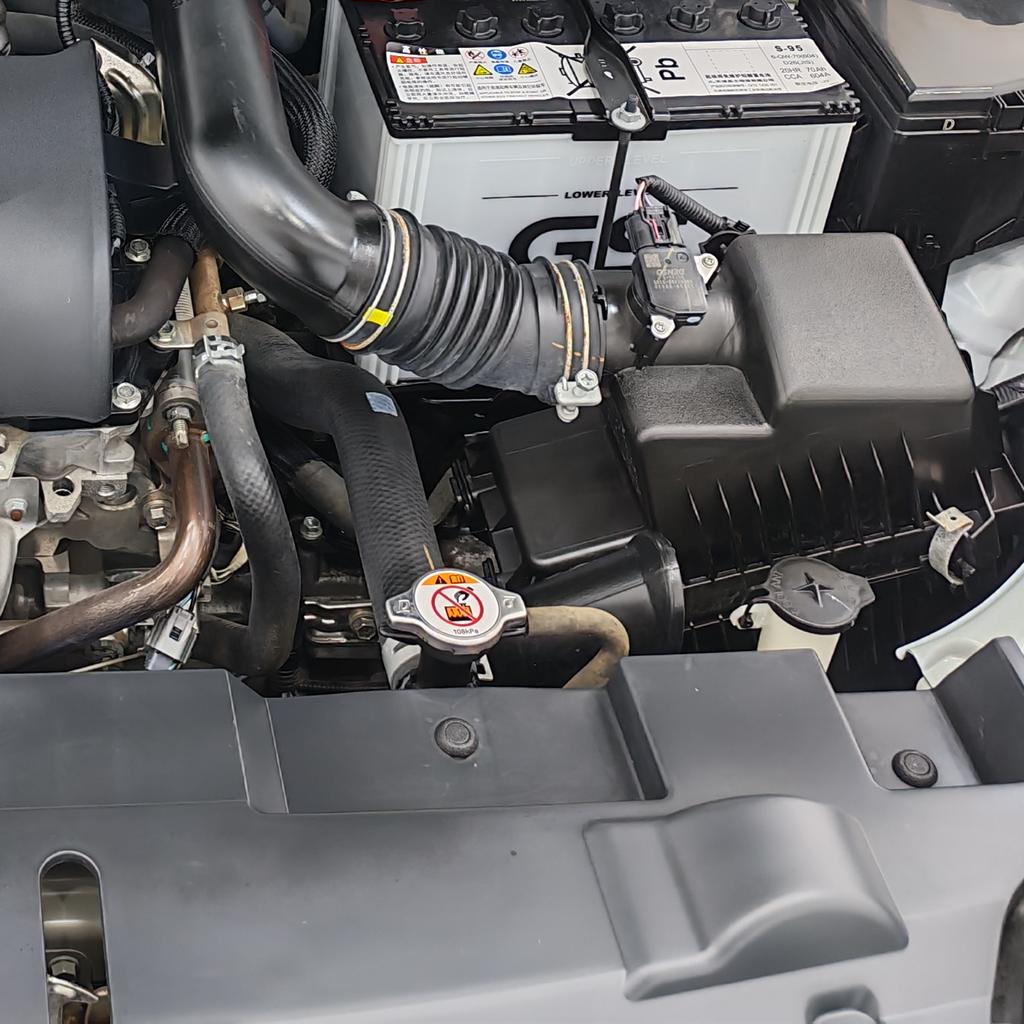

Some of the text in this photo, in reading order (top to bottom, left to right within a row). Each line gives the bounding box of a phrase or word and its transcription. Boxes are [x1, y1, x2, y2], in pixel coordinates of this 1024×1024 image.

[774, 44, 804, 52] S-95
[655, 57, 686, 81] Pb
[942, 118, 956, 131] D
